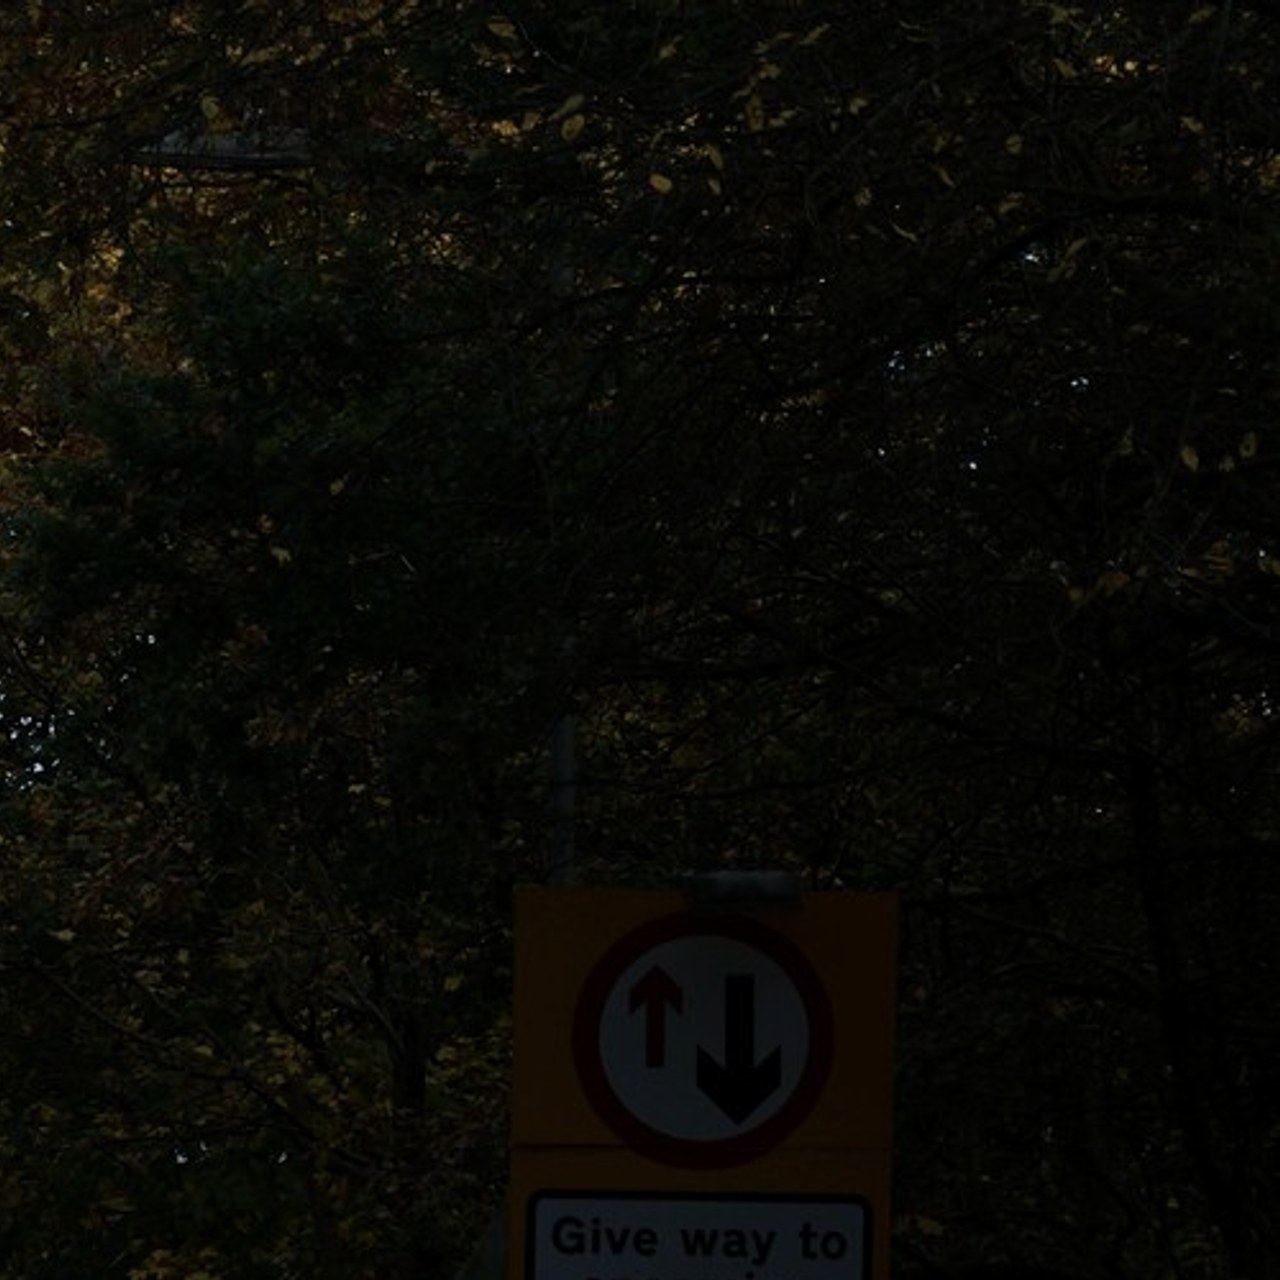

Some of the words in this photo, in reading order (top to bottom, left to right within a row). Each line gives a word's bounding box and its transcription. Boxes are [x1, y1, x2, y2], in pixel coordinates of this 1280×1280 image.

[552, 1216, 658, 1254] Give
[681, 1227, 776, 1265] way
[800, 1221, 847, 1260] to
